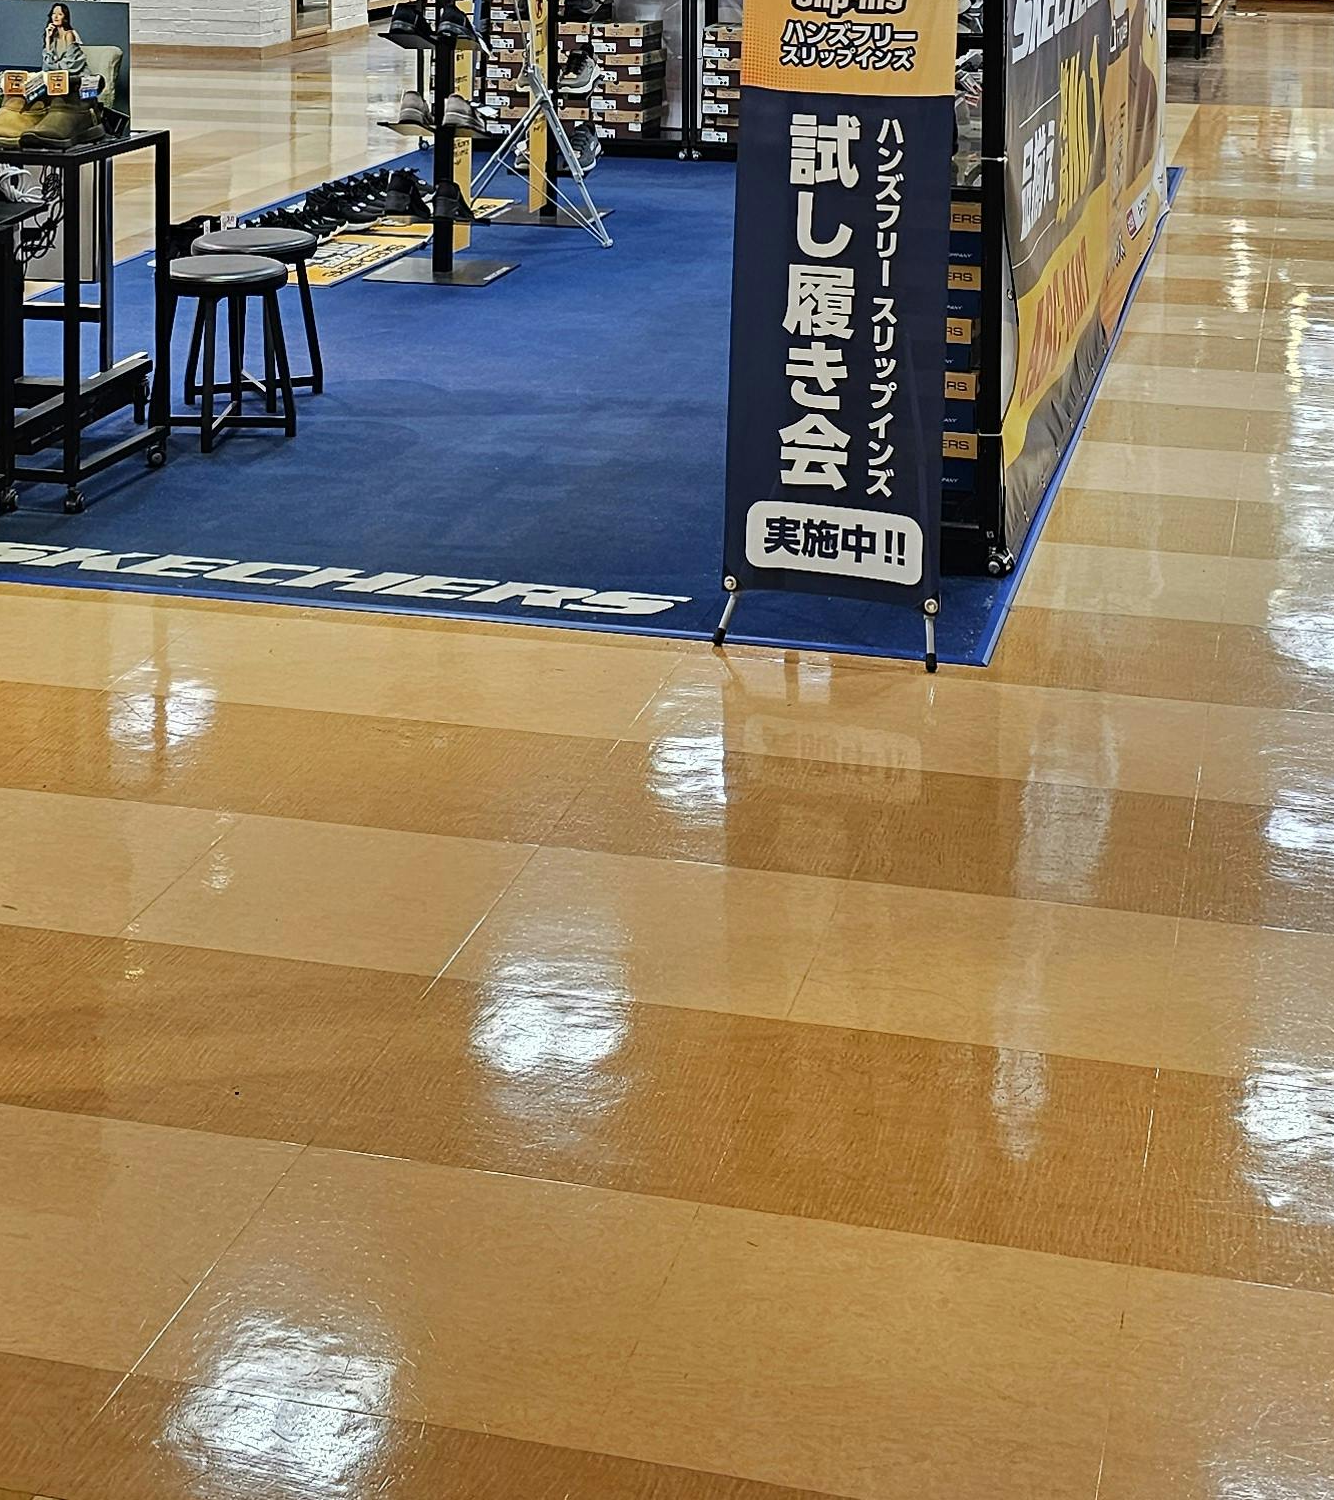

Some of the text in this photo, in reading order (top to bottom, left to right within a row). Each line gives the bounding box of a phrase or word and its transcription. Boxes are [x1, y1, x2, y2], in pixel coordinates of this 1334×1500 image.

[781, 45, 915, 70] スリップインズ
[782, 21, 917, 47] ハンズフリー
[873, 117, 905, 288] ハンズフリー
[778, 113, 862, 491] 試し履き会
[1019, 235, 1091, 401] ABC-MART
[865, 296, 901, 498] スリップインズ
[763, 514, 907, 567] 実施中!!
